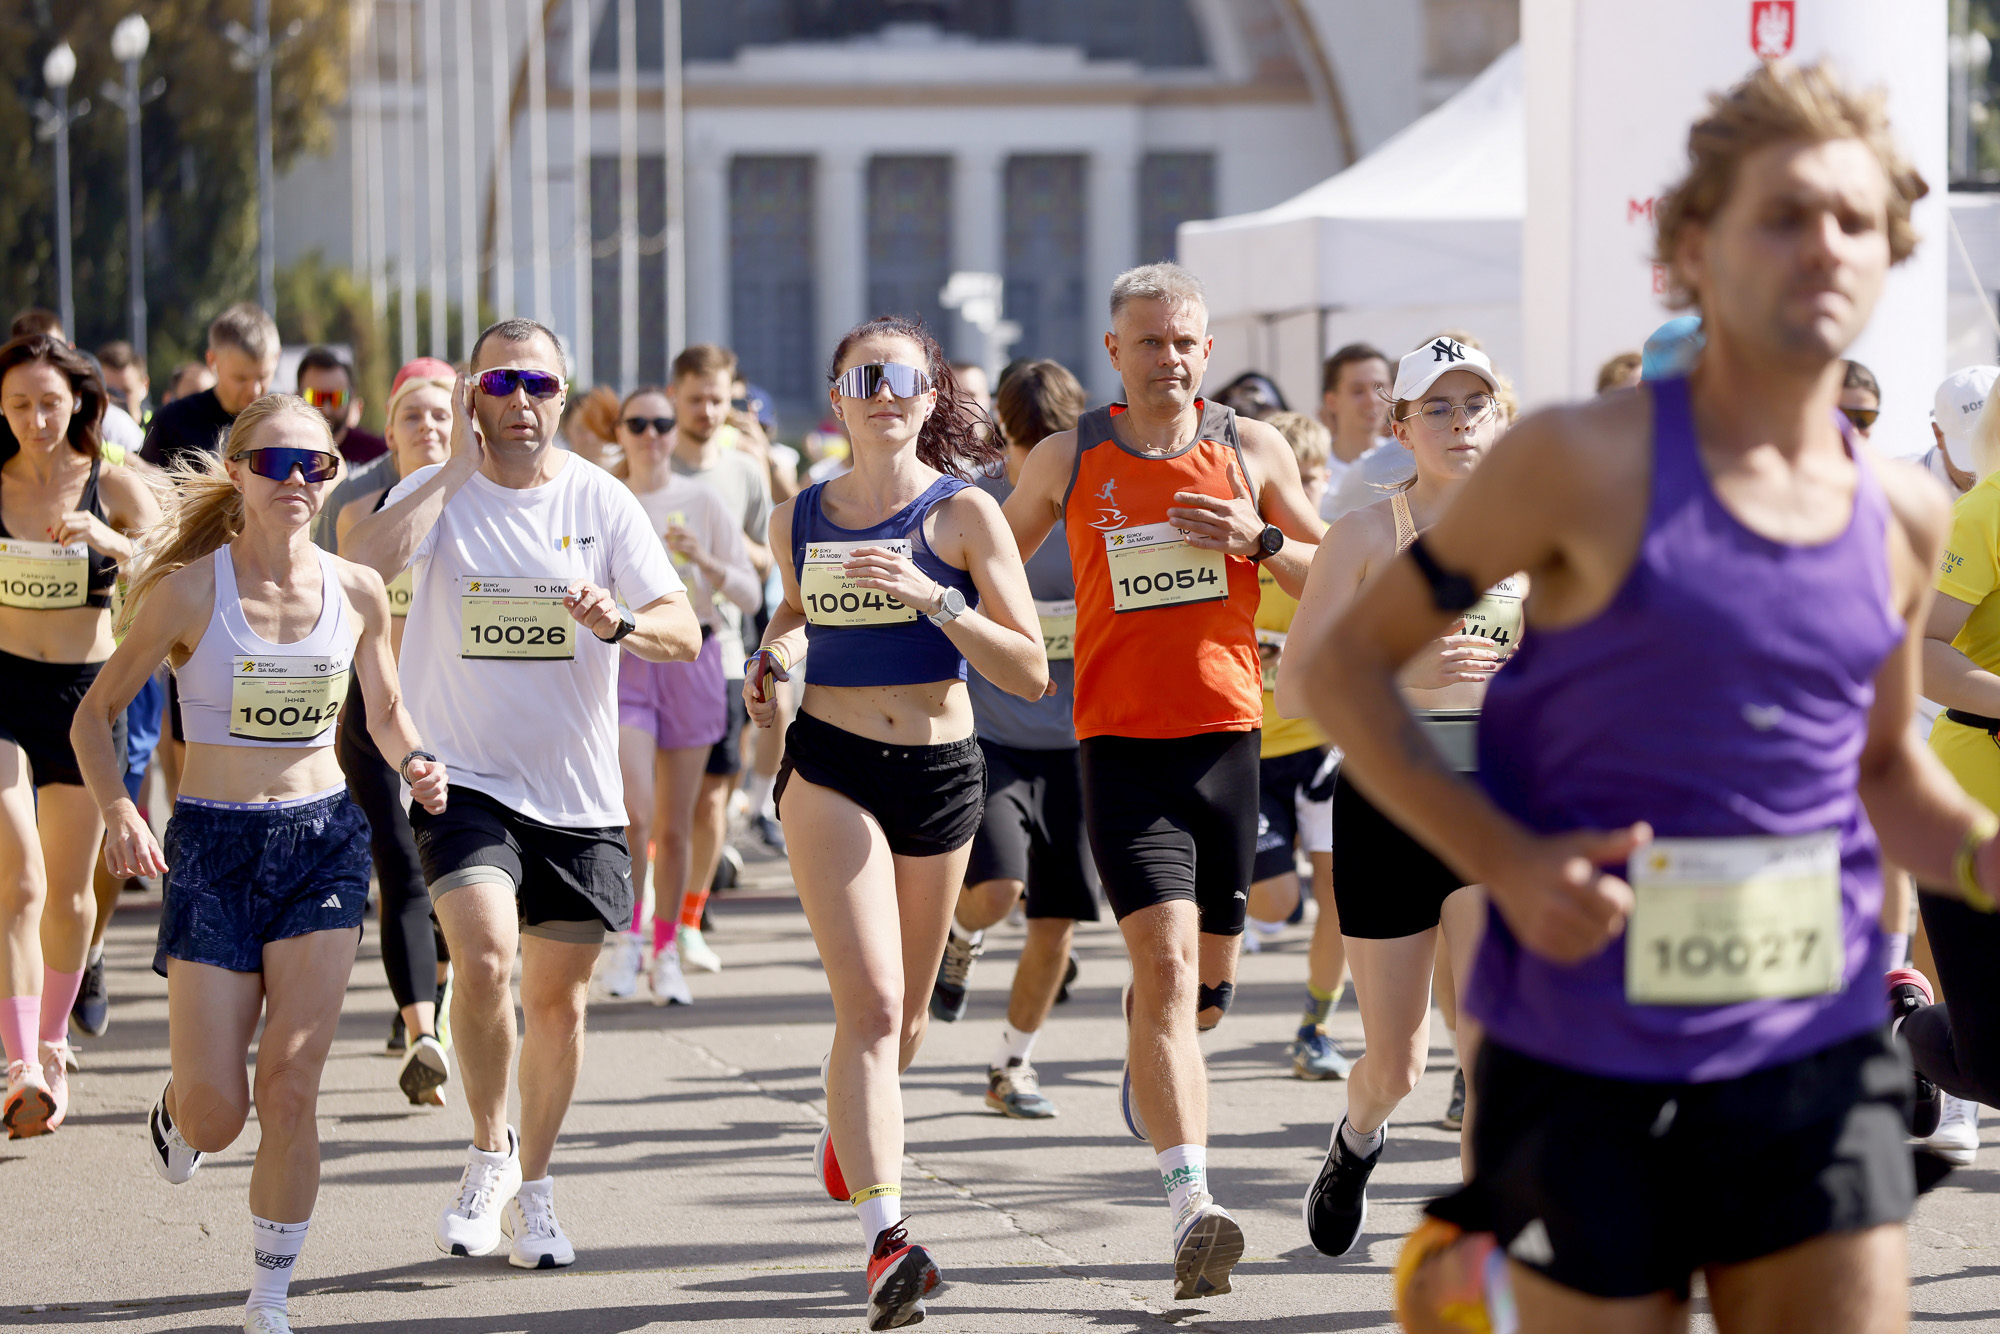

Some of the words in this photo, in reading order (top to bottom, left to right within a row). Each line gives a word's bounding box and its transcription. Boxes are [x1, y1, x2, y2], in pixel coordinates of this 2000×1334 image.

[1, 580, 78, 598] 10022
[534, 585, 547, 593] 10
[1119, 567, 1218, 597] 10054
[498, 615, 538, 623] Григорій
[470, 625, 566, 645] 10026
[314, 664, 327, 672] 10
[240, 701, 339, 727] 10042
[1652, 929, 1820, 977] 10027
